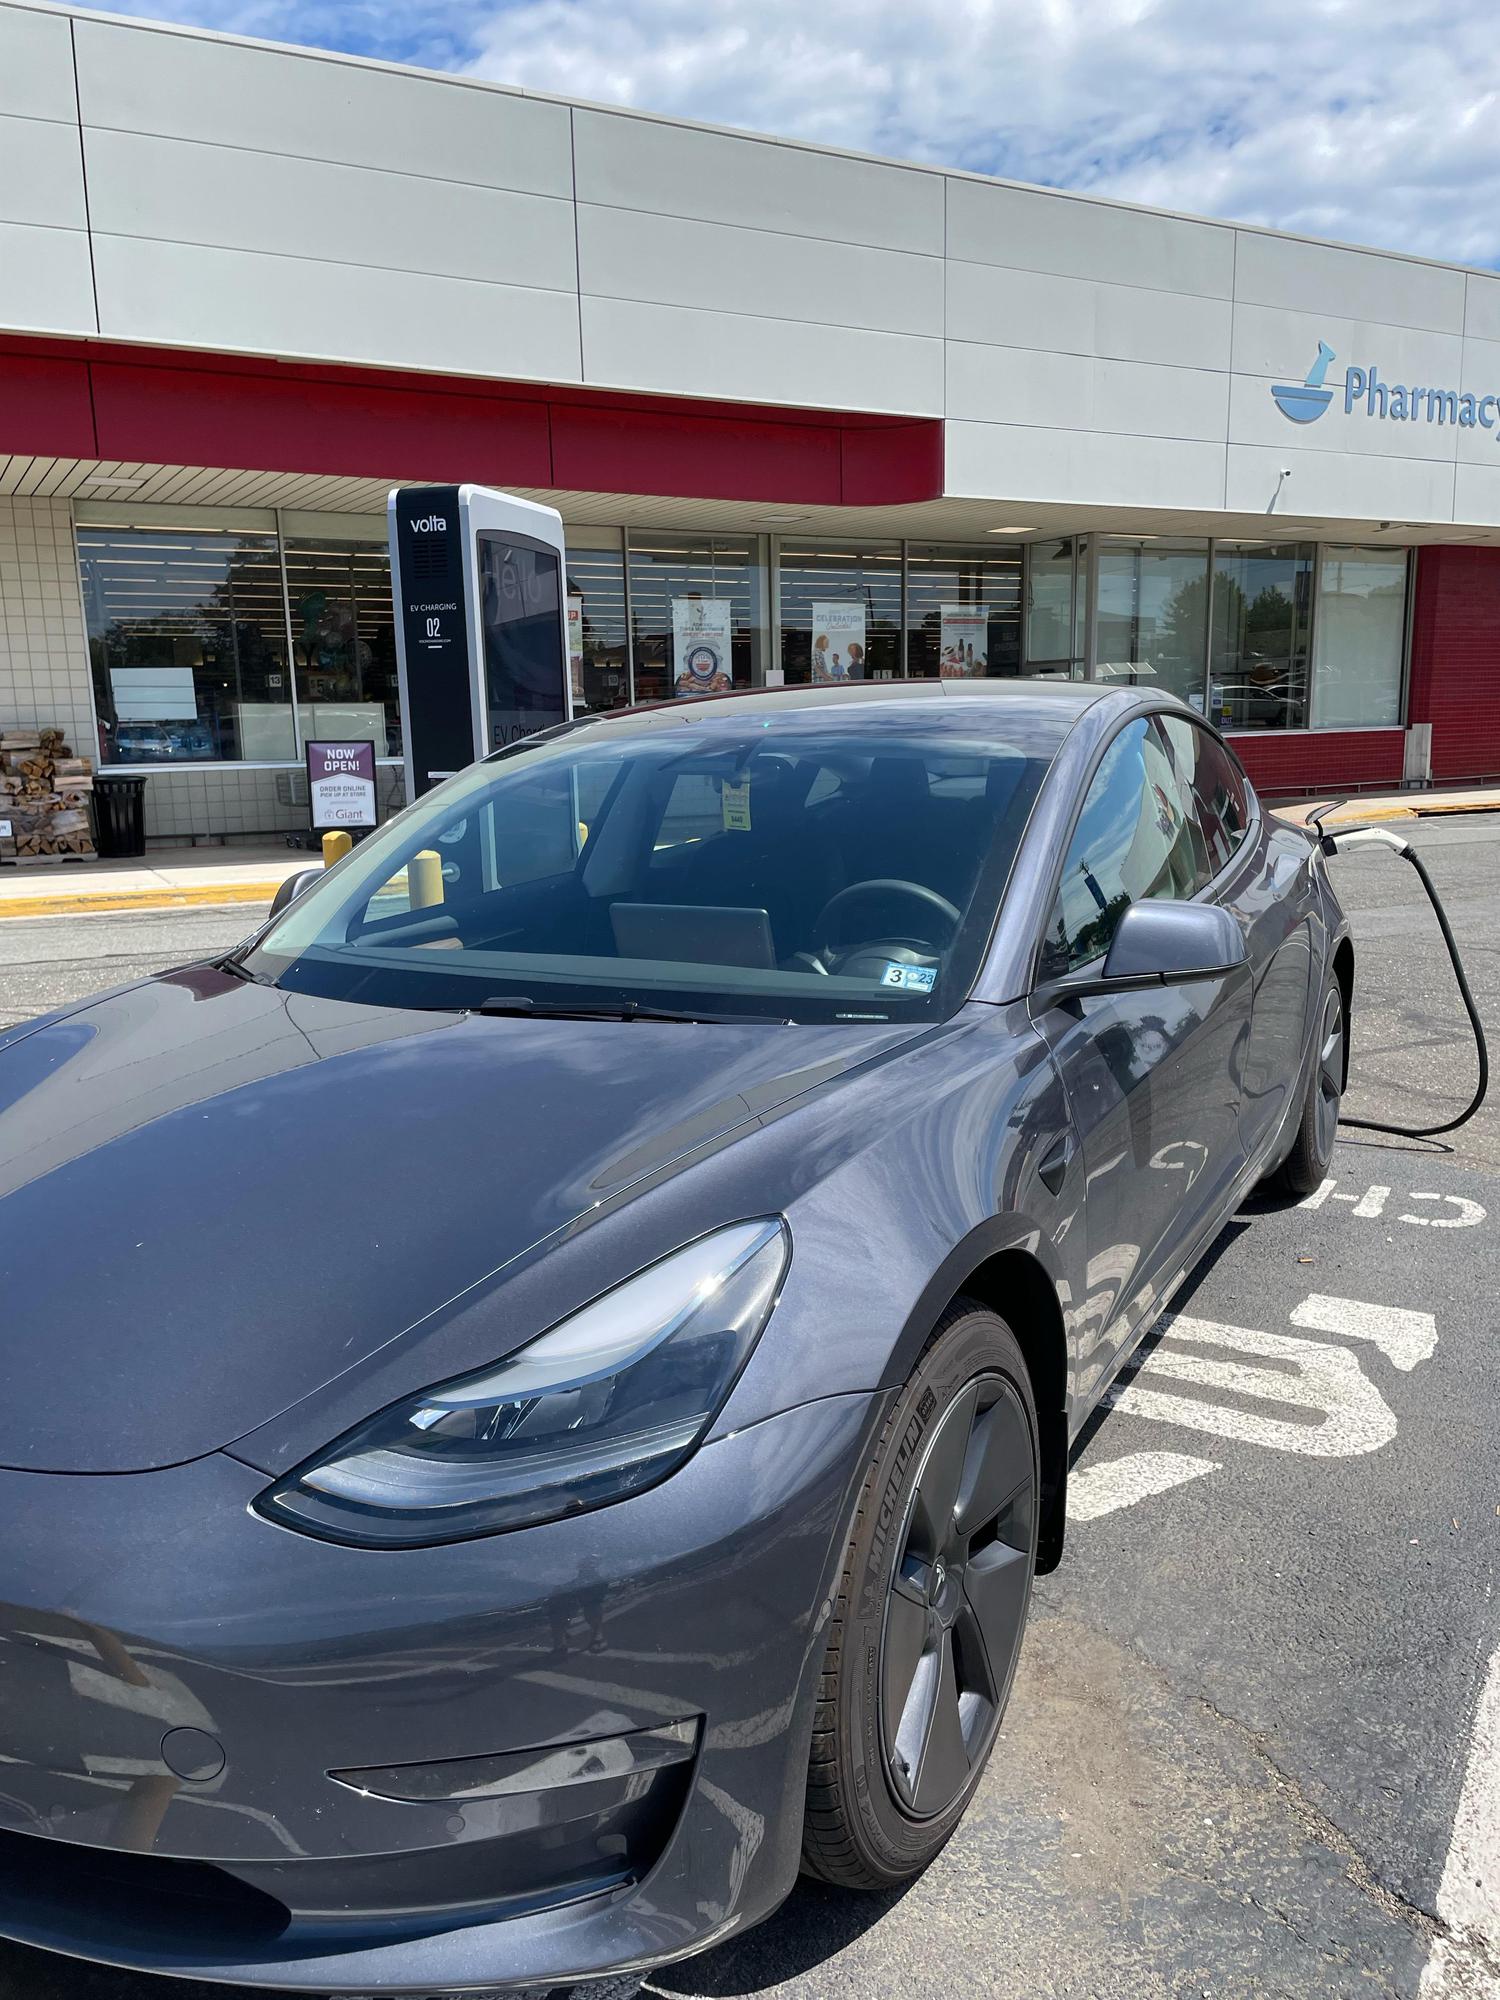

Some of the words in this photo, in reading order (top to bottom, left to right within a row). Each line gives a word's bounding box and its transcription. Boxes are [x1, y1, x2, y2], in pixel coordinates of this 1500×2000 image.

[1345, 366, 1500, 441] Pharmac
[410, 515, 447, 533] volta
[410, 604, 419, 612] EV
[420, 603, 457, 612] CHARGING
[426, 617, 441, 637] 02
[494, 725, 507, 745] EV
[327, 749, 355, 760] NOW
[324, 761, 360, 772] OPEN!
[343, 785, 366, 793] ONLINE
[336, 809, 363, 819] Giant
[890, 969, 903, 983] 3
[918, 973, 934, 985] 23
[868, 1414, 923, 1575] MICHELIN
